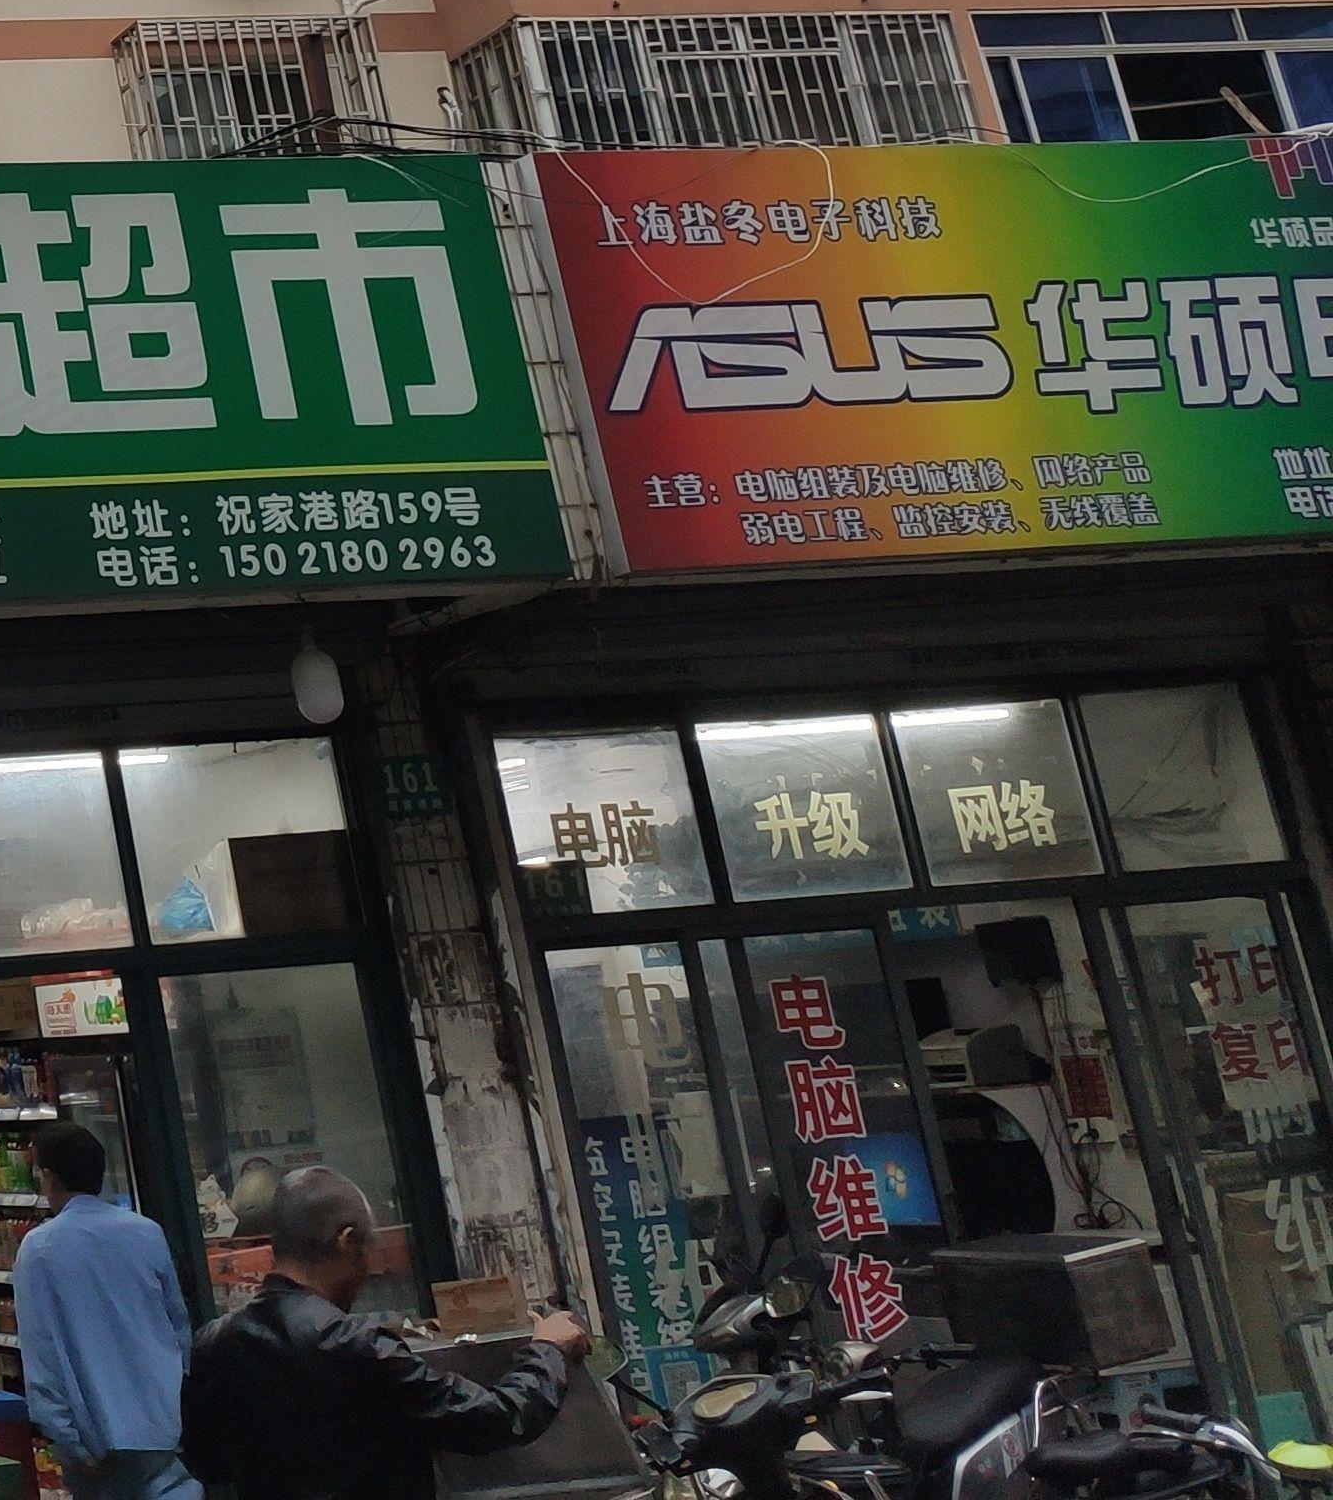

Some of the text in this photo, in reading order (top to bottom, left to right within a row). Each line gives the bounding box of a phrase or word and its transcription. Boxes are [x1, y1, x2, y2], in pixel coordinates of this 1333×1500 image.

[597, 196, 942, 248] 上海盐冬电子科技
[608, 296, 1014, 412] ASUS
[298, 539, 389, 575] 2180
[401, 534, 498, 571] 2963
[549, 779, 1058, 869] 电脑 升级 网络
[1195, 944, 1291, 1007] 打印
[1211, 1018, 1310, 1083] 复印
[769, 973, 910, 1345] 电脑维修
